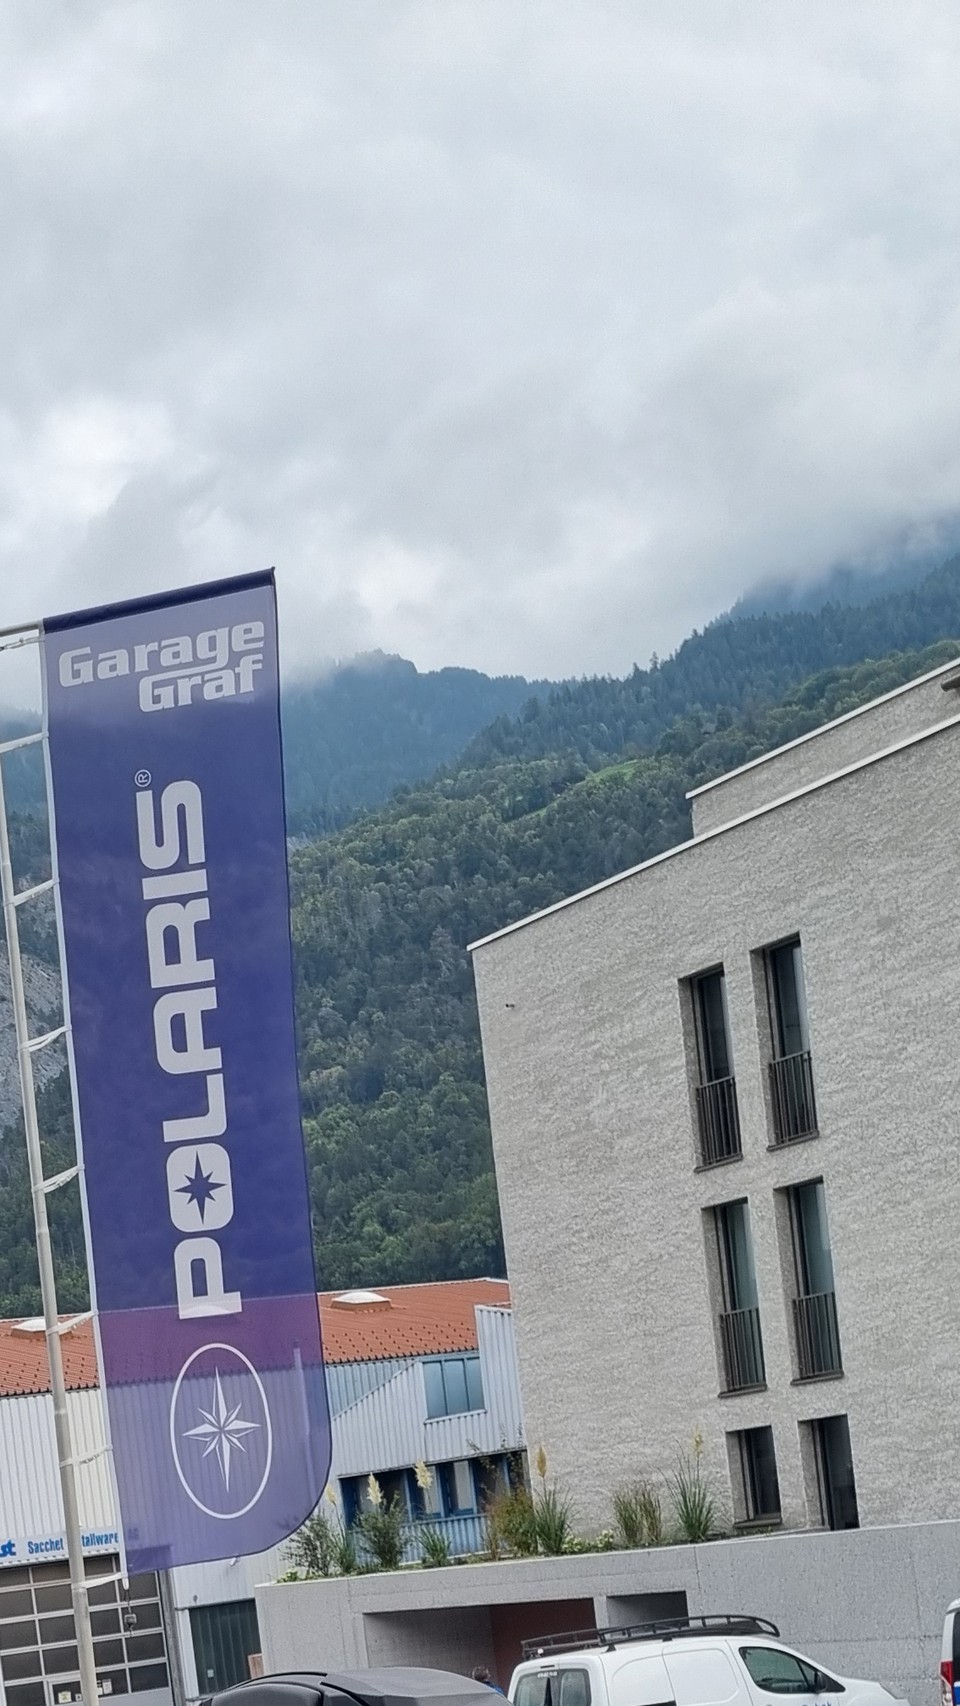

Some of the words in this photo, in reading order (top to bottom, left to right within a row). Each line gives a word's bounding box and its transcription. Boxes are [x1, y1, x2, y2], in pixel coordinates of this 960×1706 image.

[59, 621, 264, 687] Garage
[140, 653, 263, 712] Graf
[81, 1532, 119, 1547] tallware
